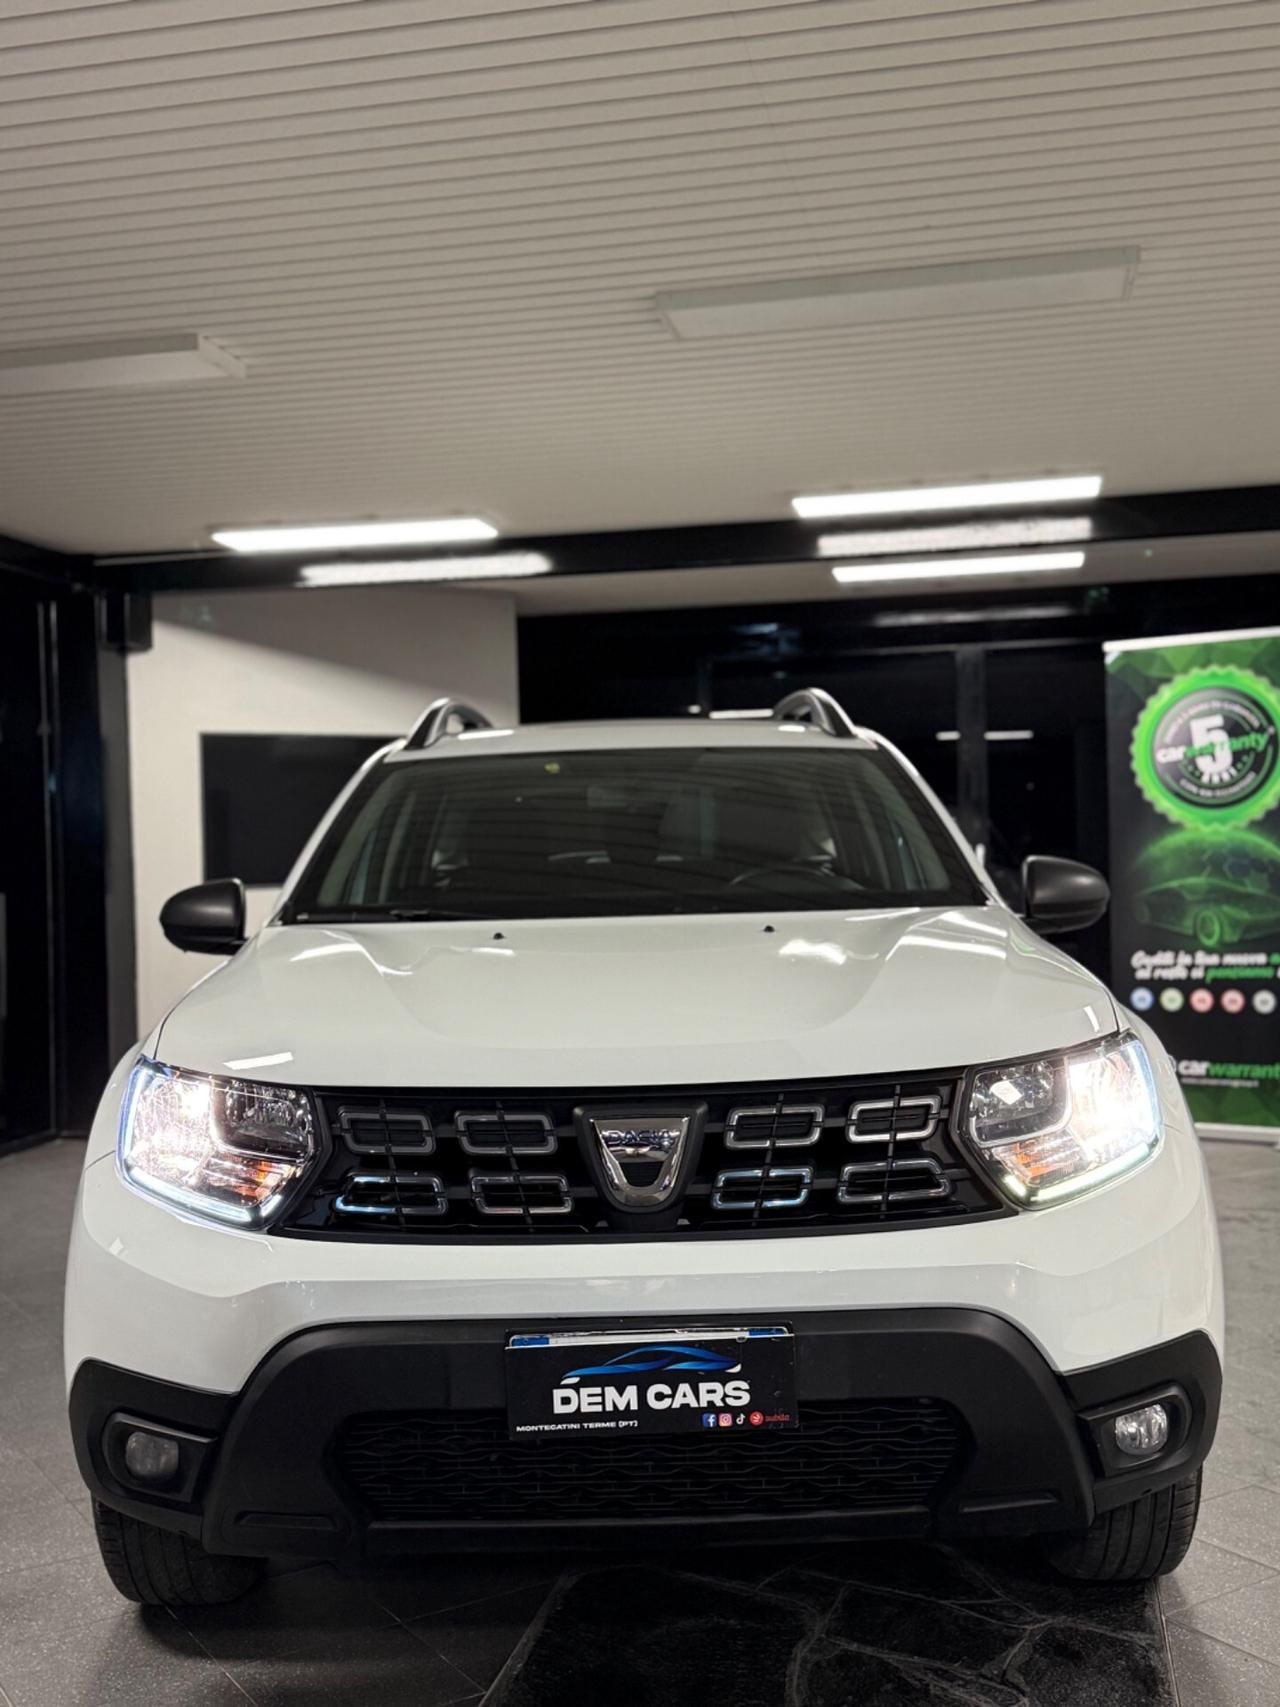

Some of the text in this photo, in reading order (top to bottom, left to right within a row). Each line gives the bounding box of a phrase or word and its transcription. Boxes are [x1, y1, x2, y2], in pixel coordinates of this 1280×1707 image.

[552, 1379, 751, 1415] DEM CARS
[516, 1423, 581, 1433] MONTECATINI
[582, 1421, 617, 1430] TERME
